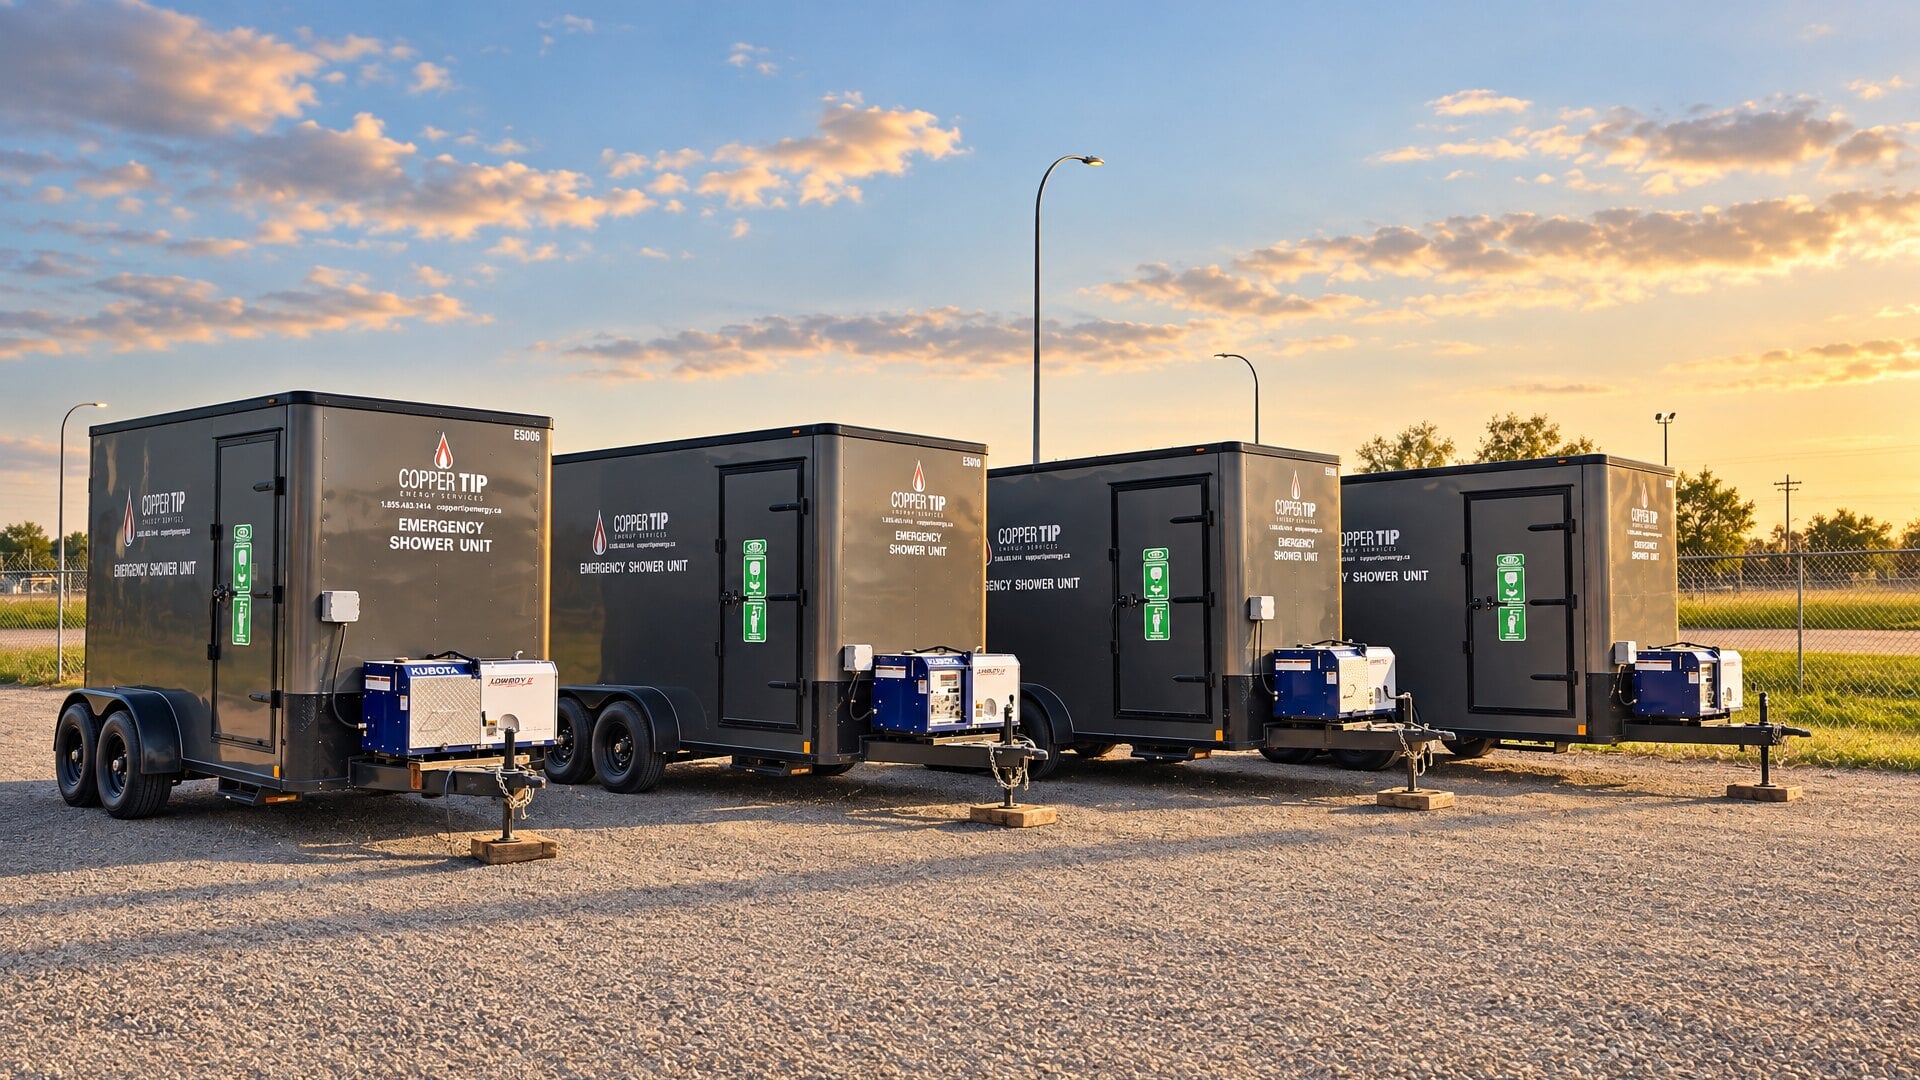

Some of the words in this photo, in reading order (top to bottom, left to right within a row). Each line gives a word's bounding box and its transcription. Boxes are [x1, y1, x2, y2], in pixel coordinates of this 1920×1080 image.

[514, 429, 540, 442] ES006
[398, 468, 455, 491] COPPER
[458, 473, 488, 493] TIP
[141, 493, 170, 516] COPPER
[170, 491, 186, 513] TIP
[891, 491, 927, 510] COPPER
[928, 494, 947, 511] TIP
[1302, 502, 1316, 518] TIP
[398, 518, 485, 534] EMERGENCY
[613, 513, 648, 532] COPPER
[649, 511, 669, 530] TIP
[895, 530, 942, 543] EMERGENCY
[998, 526, 1037, 545] COPPER
[1039, 524, 1061, 542] TIP
[1340, 530, 1374, 546] OPPER
[1375, 529, 1400, 545] TIP
[389, 536, 454, 552] SHOWER
[460, 539, 493, 553] UNIT
[889, 543, 926, 556] SHOWER
[928, 546, 947, 557] UNIT
[114, 563, 148, 578] EMERGENCY
[150, 561, 178, 577] SHOWER
[179, 560, 197, 575] UNIT
[580, 561, 626, 575] EMERGENCY
[628, 560, 664, 573] SHOWER
[667, 559, 689, 572] UNIT
[1353, 570, 1399, 582] SHOWER
[1403, 569, 1429, 581] UNIT
[1015, 578, 1054, 591] SHOWER
[1057, 577, 1080, 589] UNIT
[411, 666, 459, 675] KUBOTA
